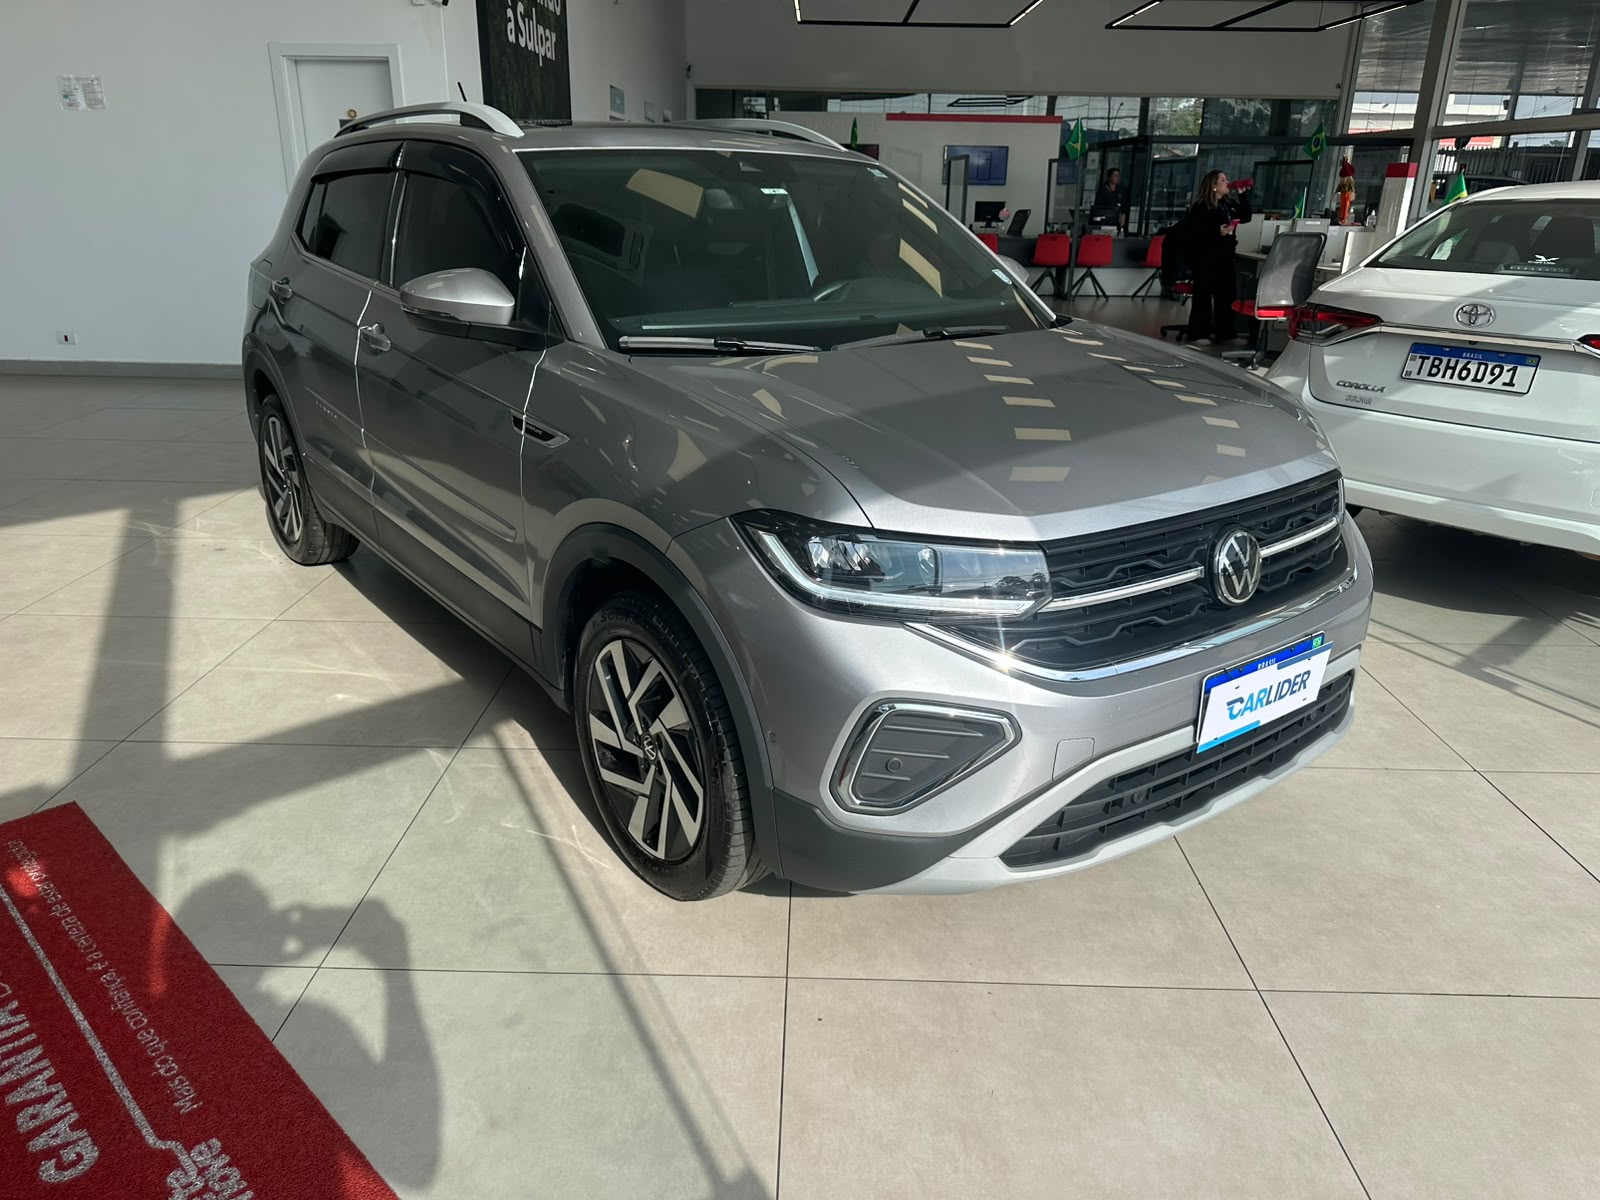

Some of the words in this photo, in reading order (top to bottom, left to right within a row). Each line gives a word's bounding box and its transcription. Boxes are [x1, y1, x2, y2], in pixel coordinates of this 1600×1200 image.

[516, 1, 556, 67] Sulpar
[1462, 352, 1483, 360] BRASIL
[1416, 355, 1519, 388] TBH6D91
[1336, 380, 1386, 393] COROLLA
[48, 901, 72, 918] de
[61, 915, 97, 953] certeza
[137, 1028, 169, 1057] que
[152, 1054, 179, 1077] do
[168, 1075, 203, 1114] Mais
